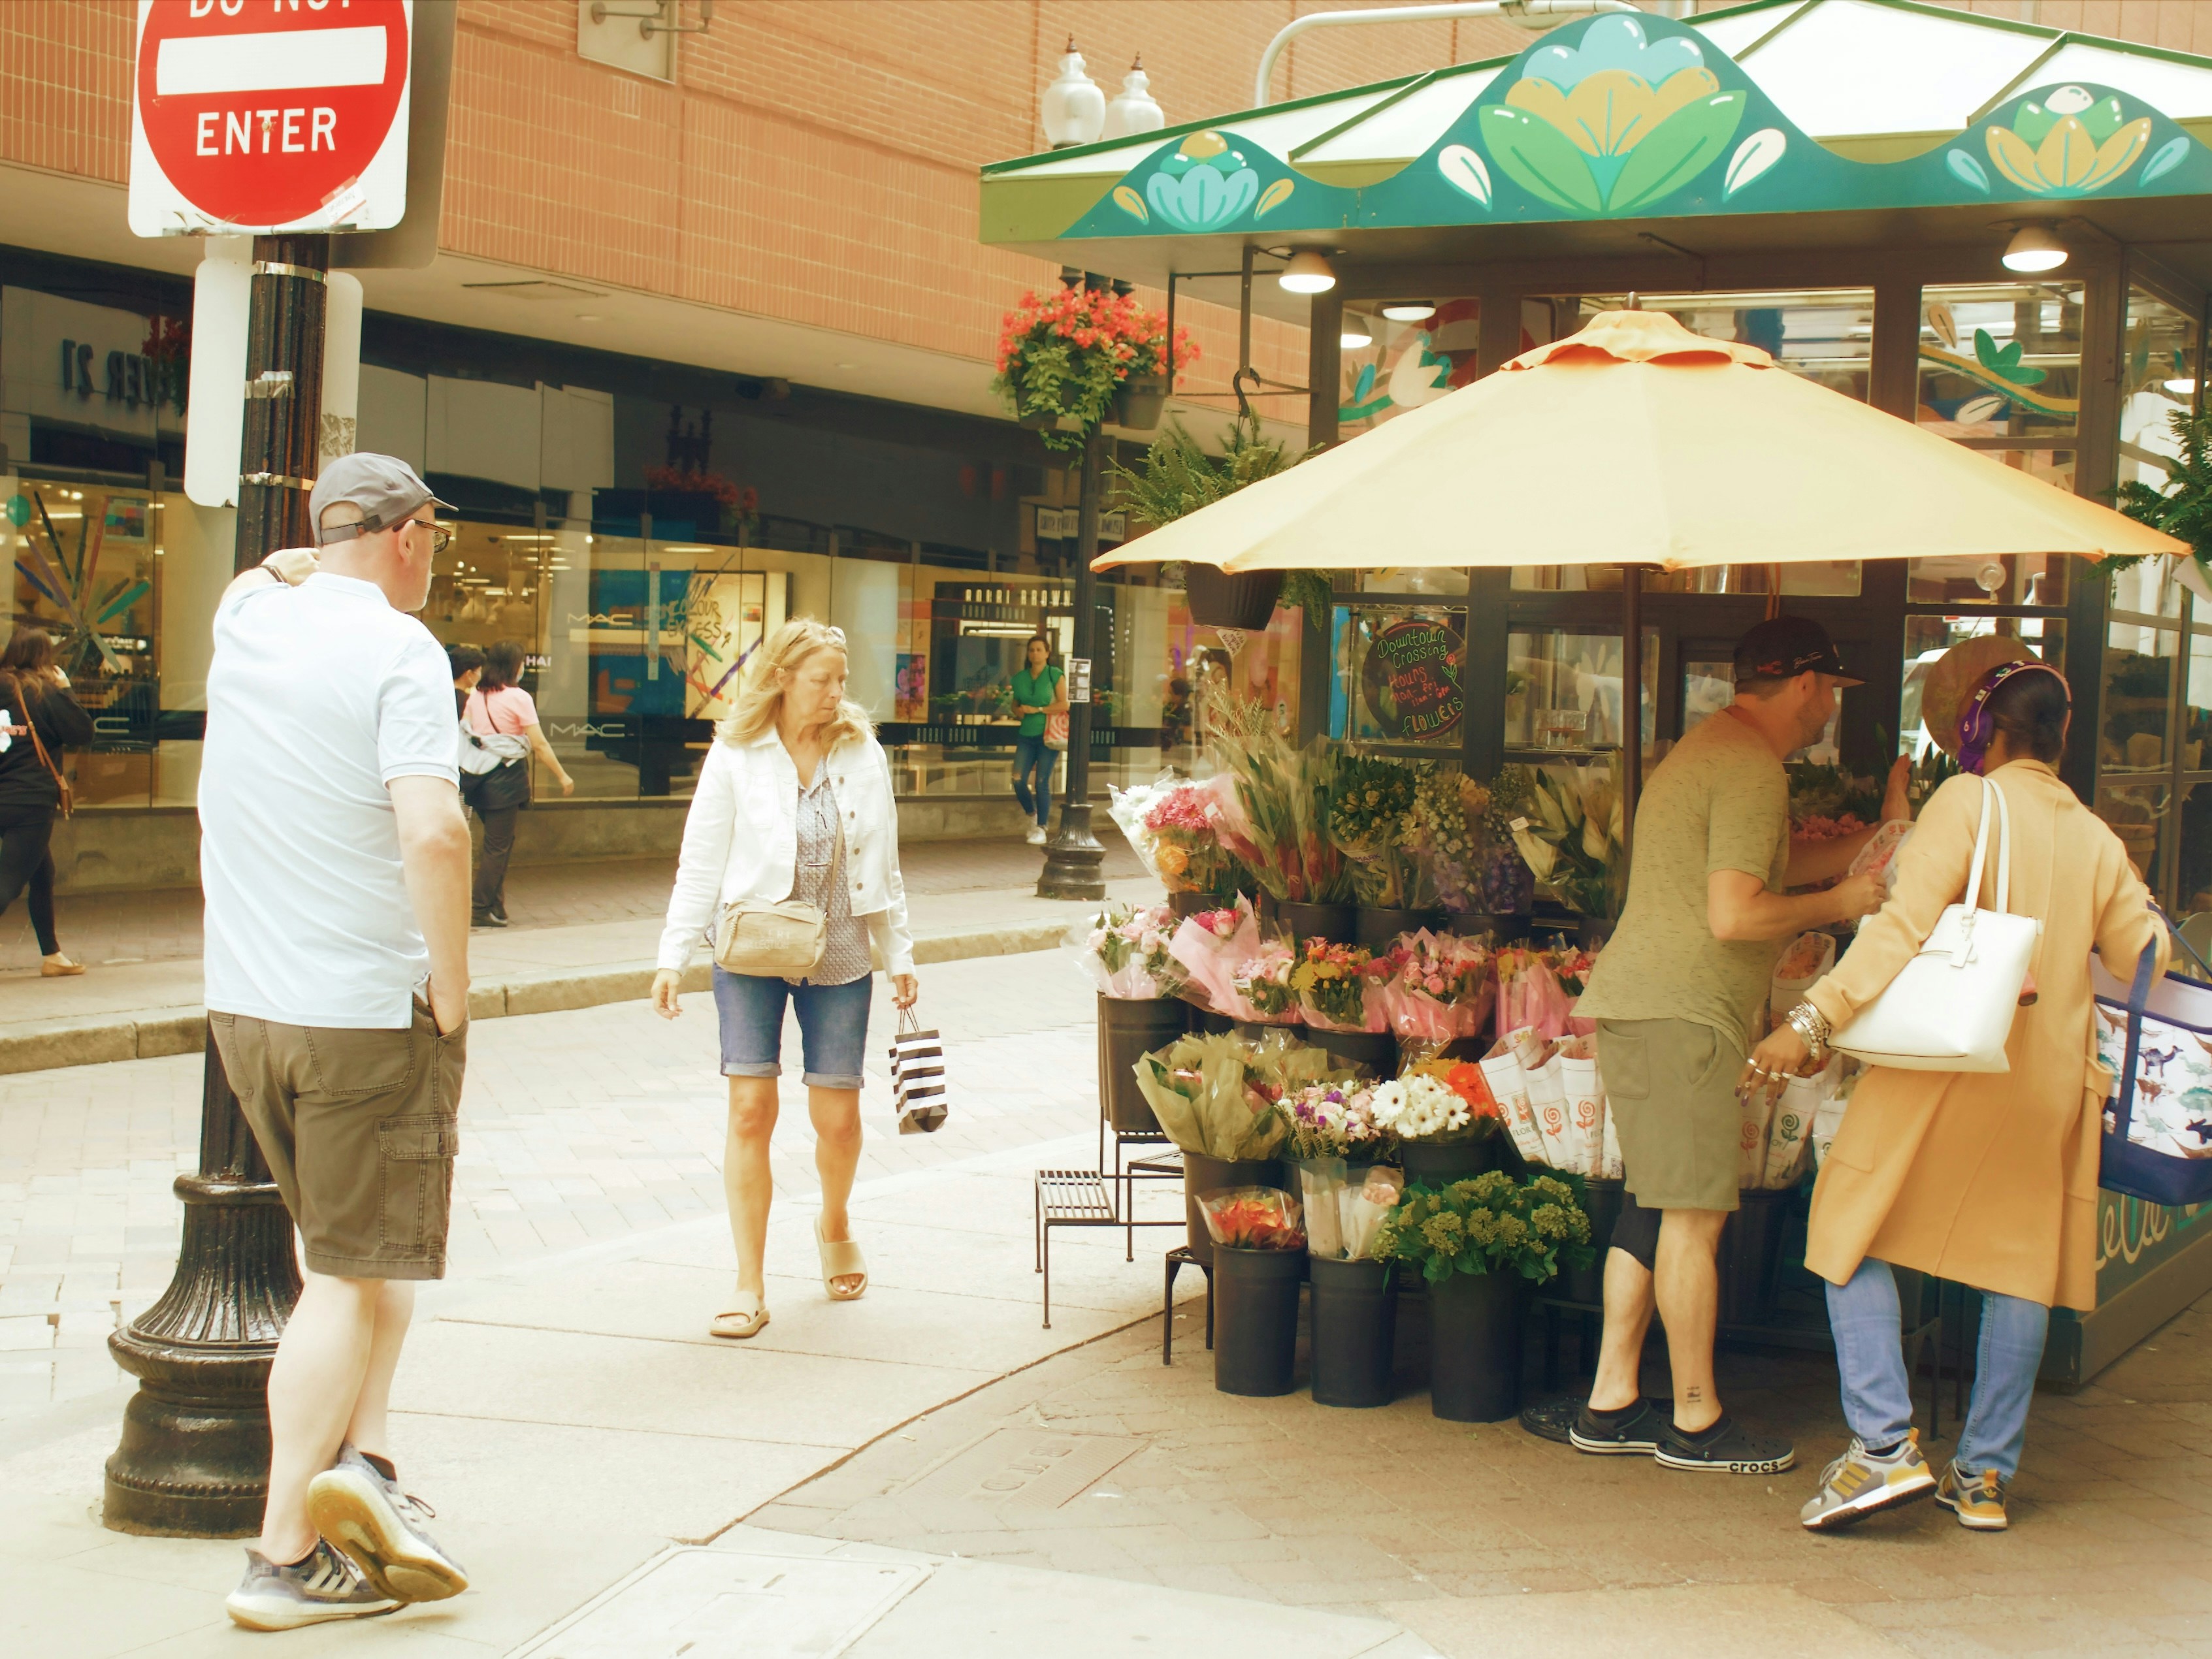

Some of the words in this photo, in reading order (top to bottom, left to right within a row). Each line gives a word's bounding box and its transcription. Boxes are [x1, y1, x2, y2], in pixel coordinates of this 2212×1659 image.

[197, 107, 336, 156] ENTER
[1377, 629, 1446, 659] Downtown
[1393, 644, 1448, 669] Crossing
[1729, 1460, 1779, 1472] crocs
